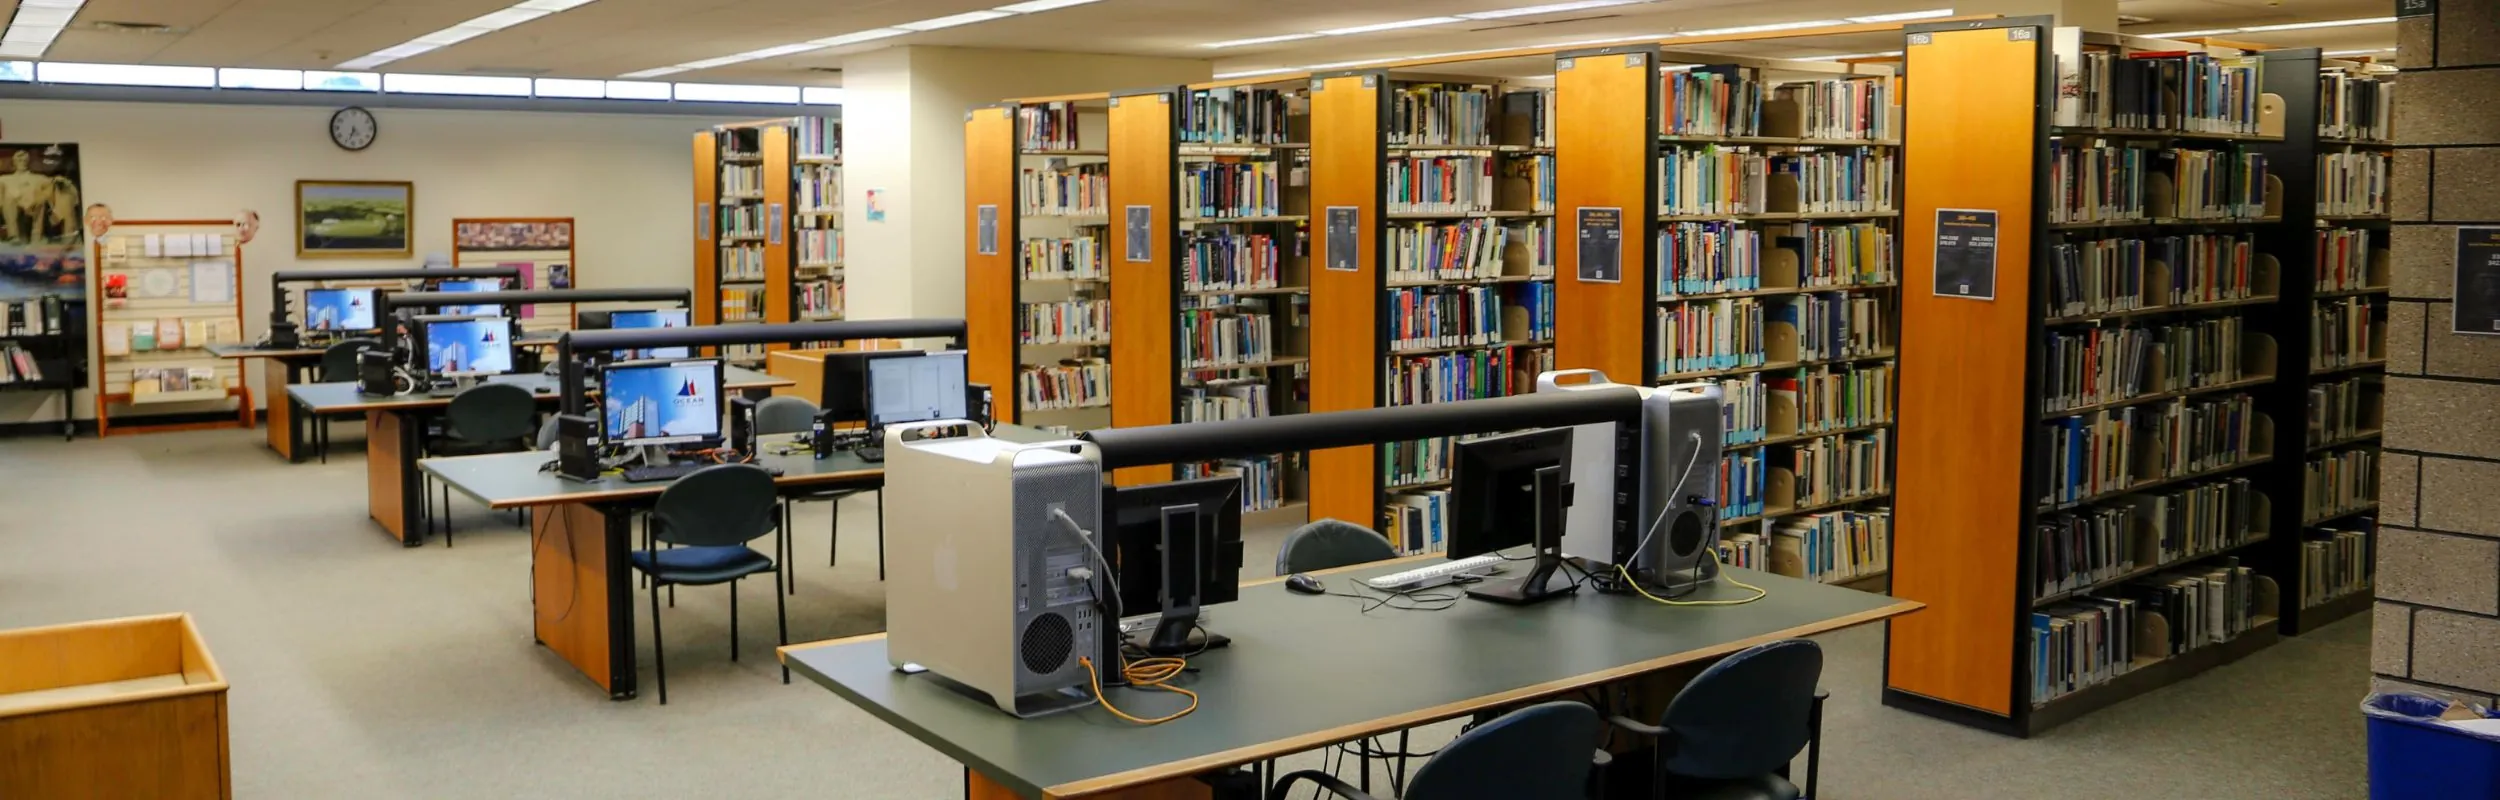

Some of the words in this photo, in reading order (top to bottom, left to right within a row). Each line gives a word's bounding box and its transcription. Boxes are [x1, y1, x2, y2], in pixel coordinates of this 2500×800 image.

[1912, 34, 1929, 45] 16b
[2012, 29, 2031, 40] 16a
[673, 397, 704, 405] OCEAN
